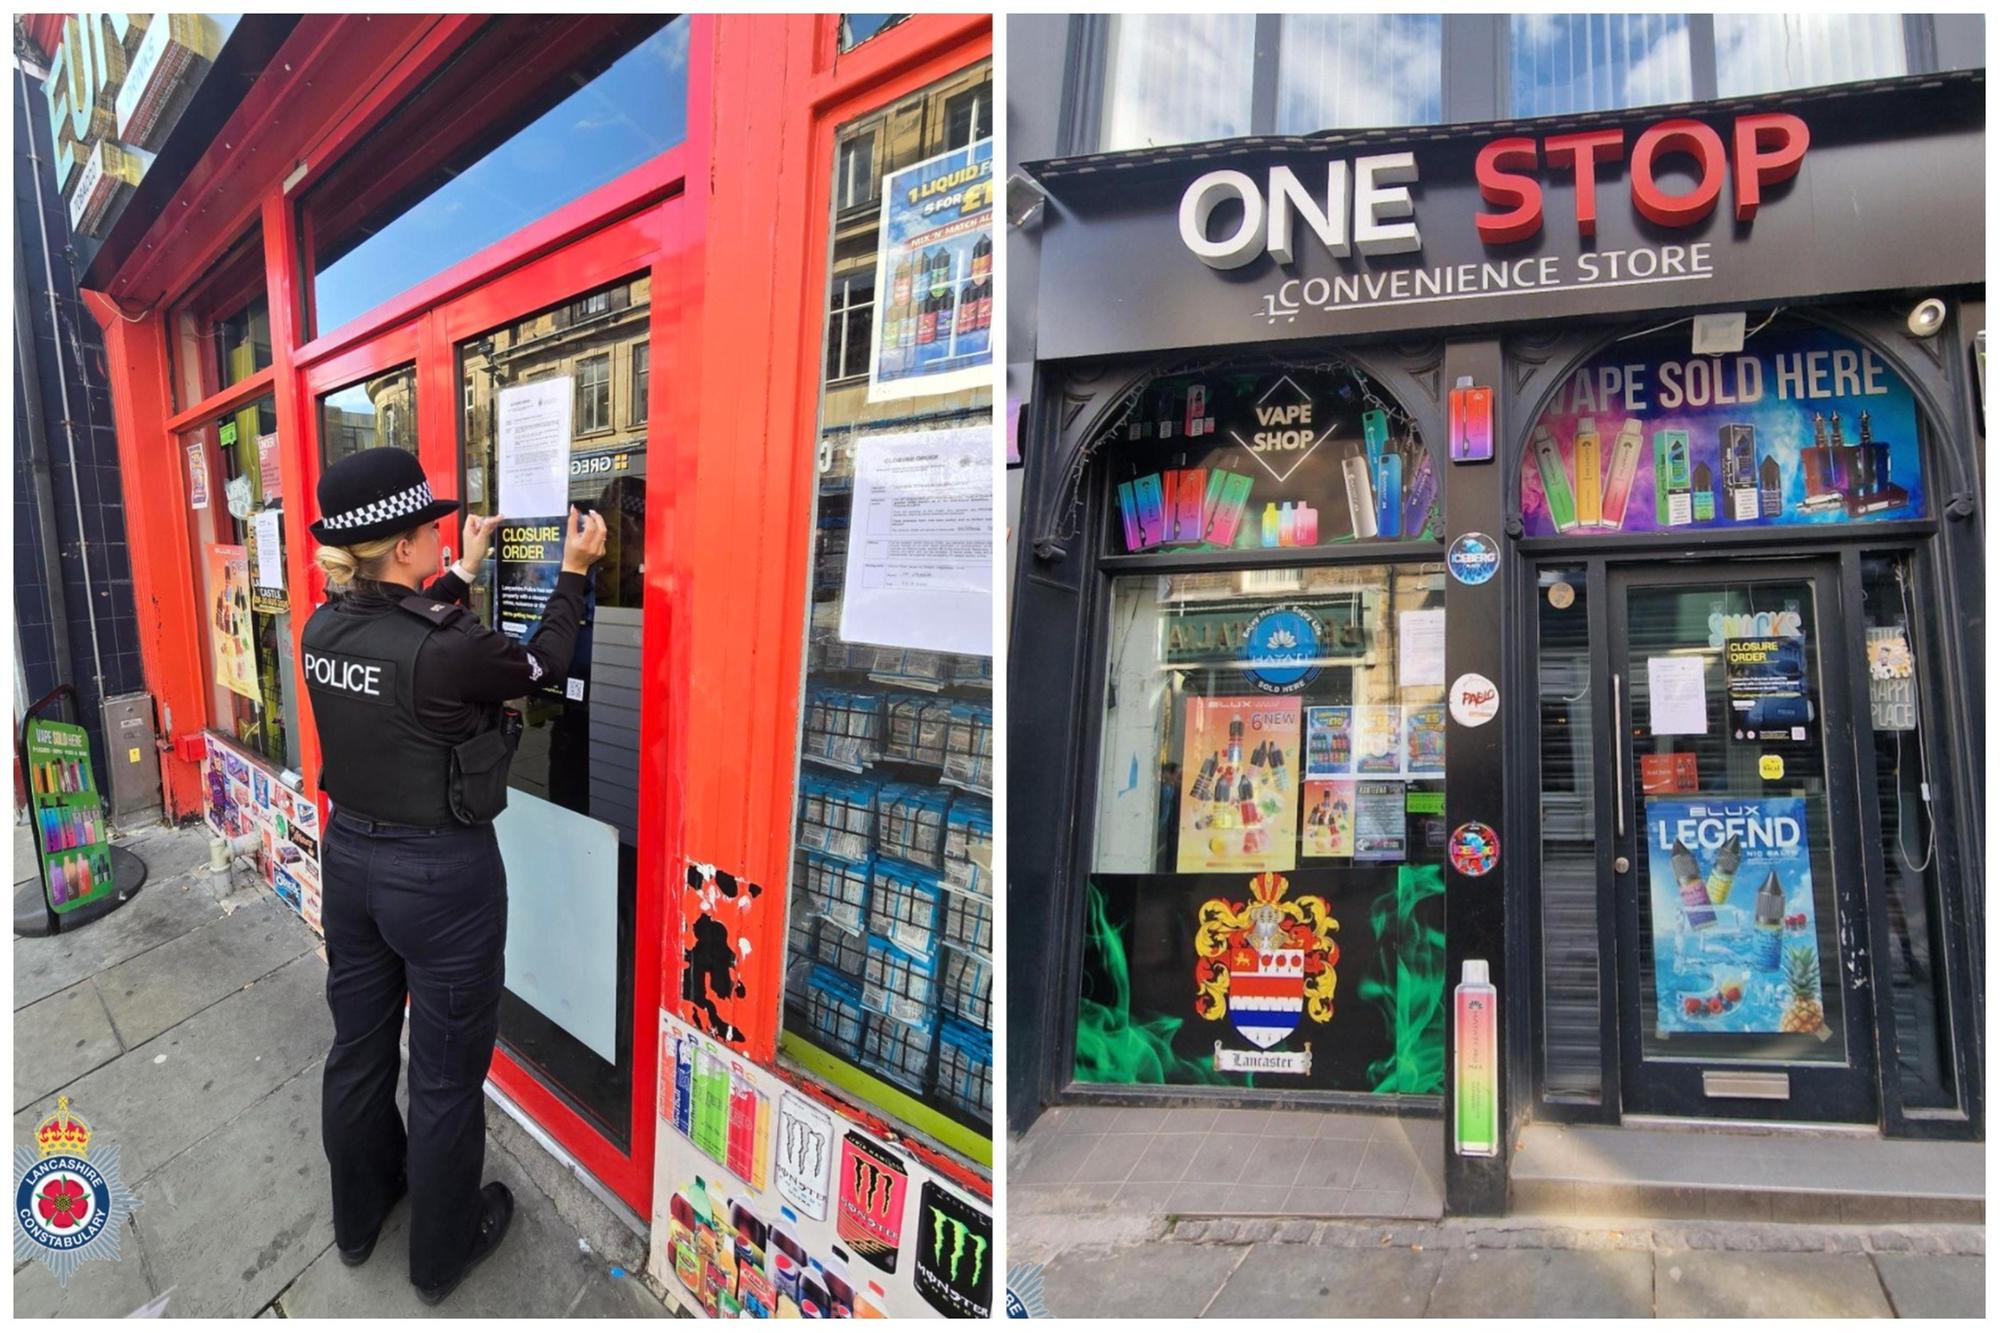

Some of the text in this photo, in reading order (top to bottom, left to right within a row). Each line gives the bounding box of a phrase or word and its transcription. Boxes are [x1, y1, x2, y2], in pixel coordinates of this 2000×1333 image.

[908, 187, 918, 204] 1
[920, 164, 978, 198] LIQUID
[1178, 111, 1811, 270] ONE STOP
[922, 202, 935, 216] 5
[935, 192, 963, 212] FOR
[911, 235, 930, 248] MIX
[944, 218, 978, 237] MATCH
[1280, 242, 1714, 309] CONVENIENCE STORE
[1659, 356, 1763, 408] SOLD
[1776, 348, 1888, 400] HERE
[1255, 404, 1313, 426] VAPE
[1252, 430, 1315, 452] SHOP
[502, 526, 560, 542] CLOSURE
[502, 545, 544, 559] ORDER
[1451, 552, 1496, 563] ICEBERG
[1730, 642, 1779, 652] CLOSURE
[1730, 652, 1767, 662] ORDER
[304, 652, 381, 696] POLICE
[1258, 680, 1281, 694] SOLD
[1462, 689, 1496, 706] PABLO
[1869, 680, 1910, 702] HAPPY
[1252, 713, 1296, 731] 6 NEW
[1871, 703, 1913, 727] PLACE
[36, 728, 52, 744] VAPE
[53, 731, 68, 746] SOLD
[1690, 806, 1759, 817] ELUX
[1658, 817, 1800, 850] LEGEND
[1233, 1053, 1294, 1070] Lancaster
[916, 1260, 989, 1319] MONSTER
